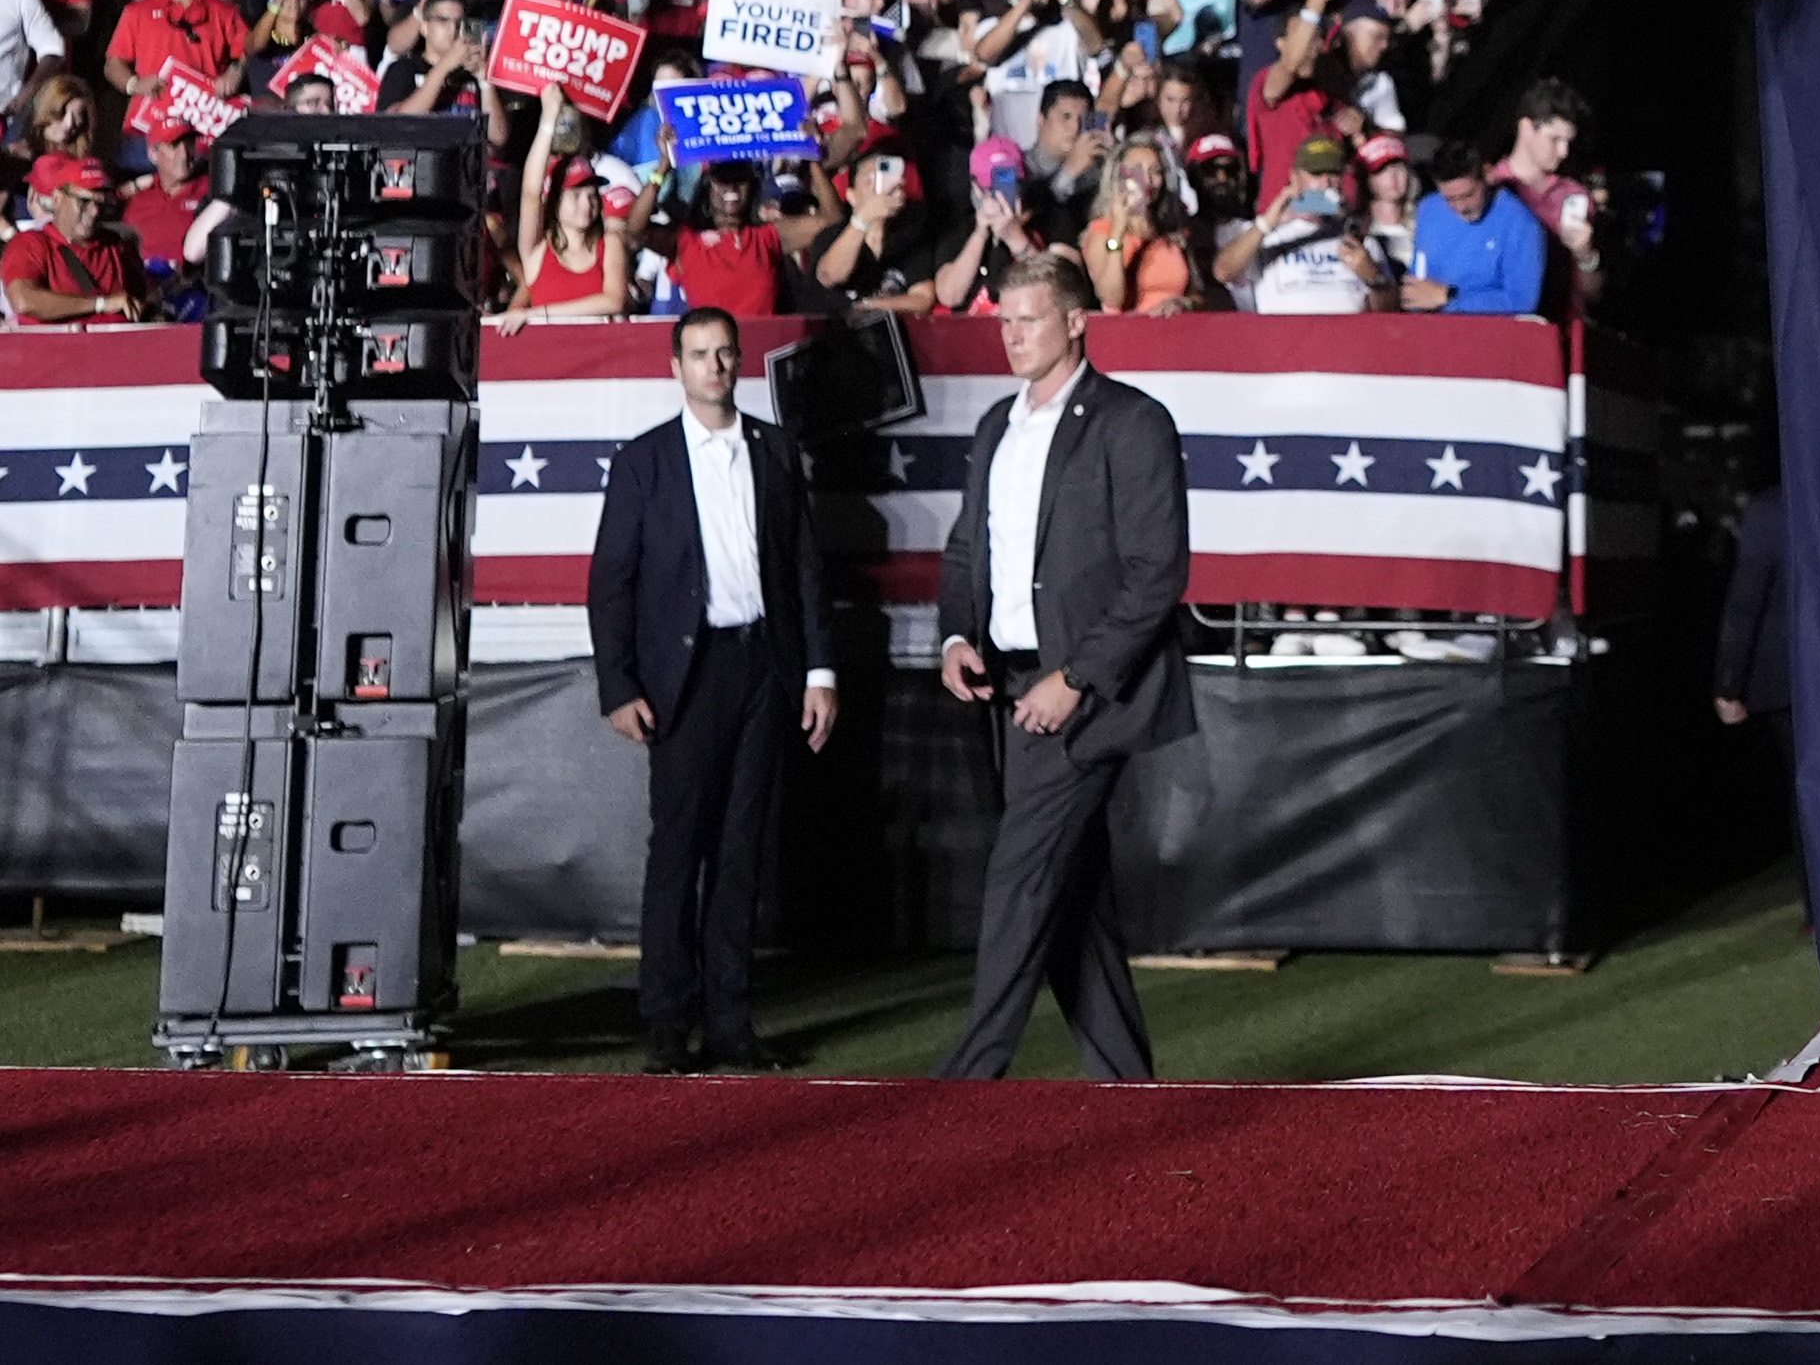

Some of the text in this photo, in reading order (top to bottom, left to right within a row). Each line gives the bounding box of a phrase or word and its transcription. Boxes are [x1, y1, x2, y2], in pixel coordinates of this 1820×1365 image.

[733, 0, 820, 29] YOU'RE
[517, 9, 629, 64] TRUMP
[720, 18, 824, 55] FIRED!
[524, 36, 606, 84] 2024
[674, 90, 793, 119] TRUMP
[698, 111, 784, 136] 2024
